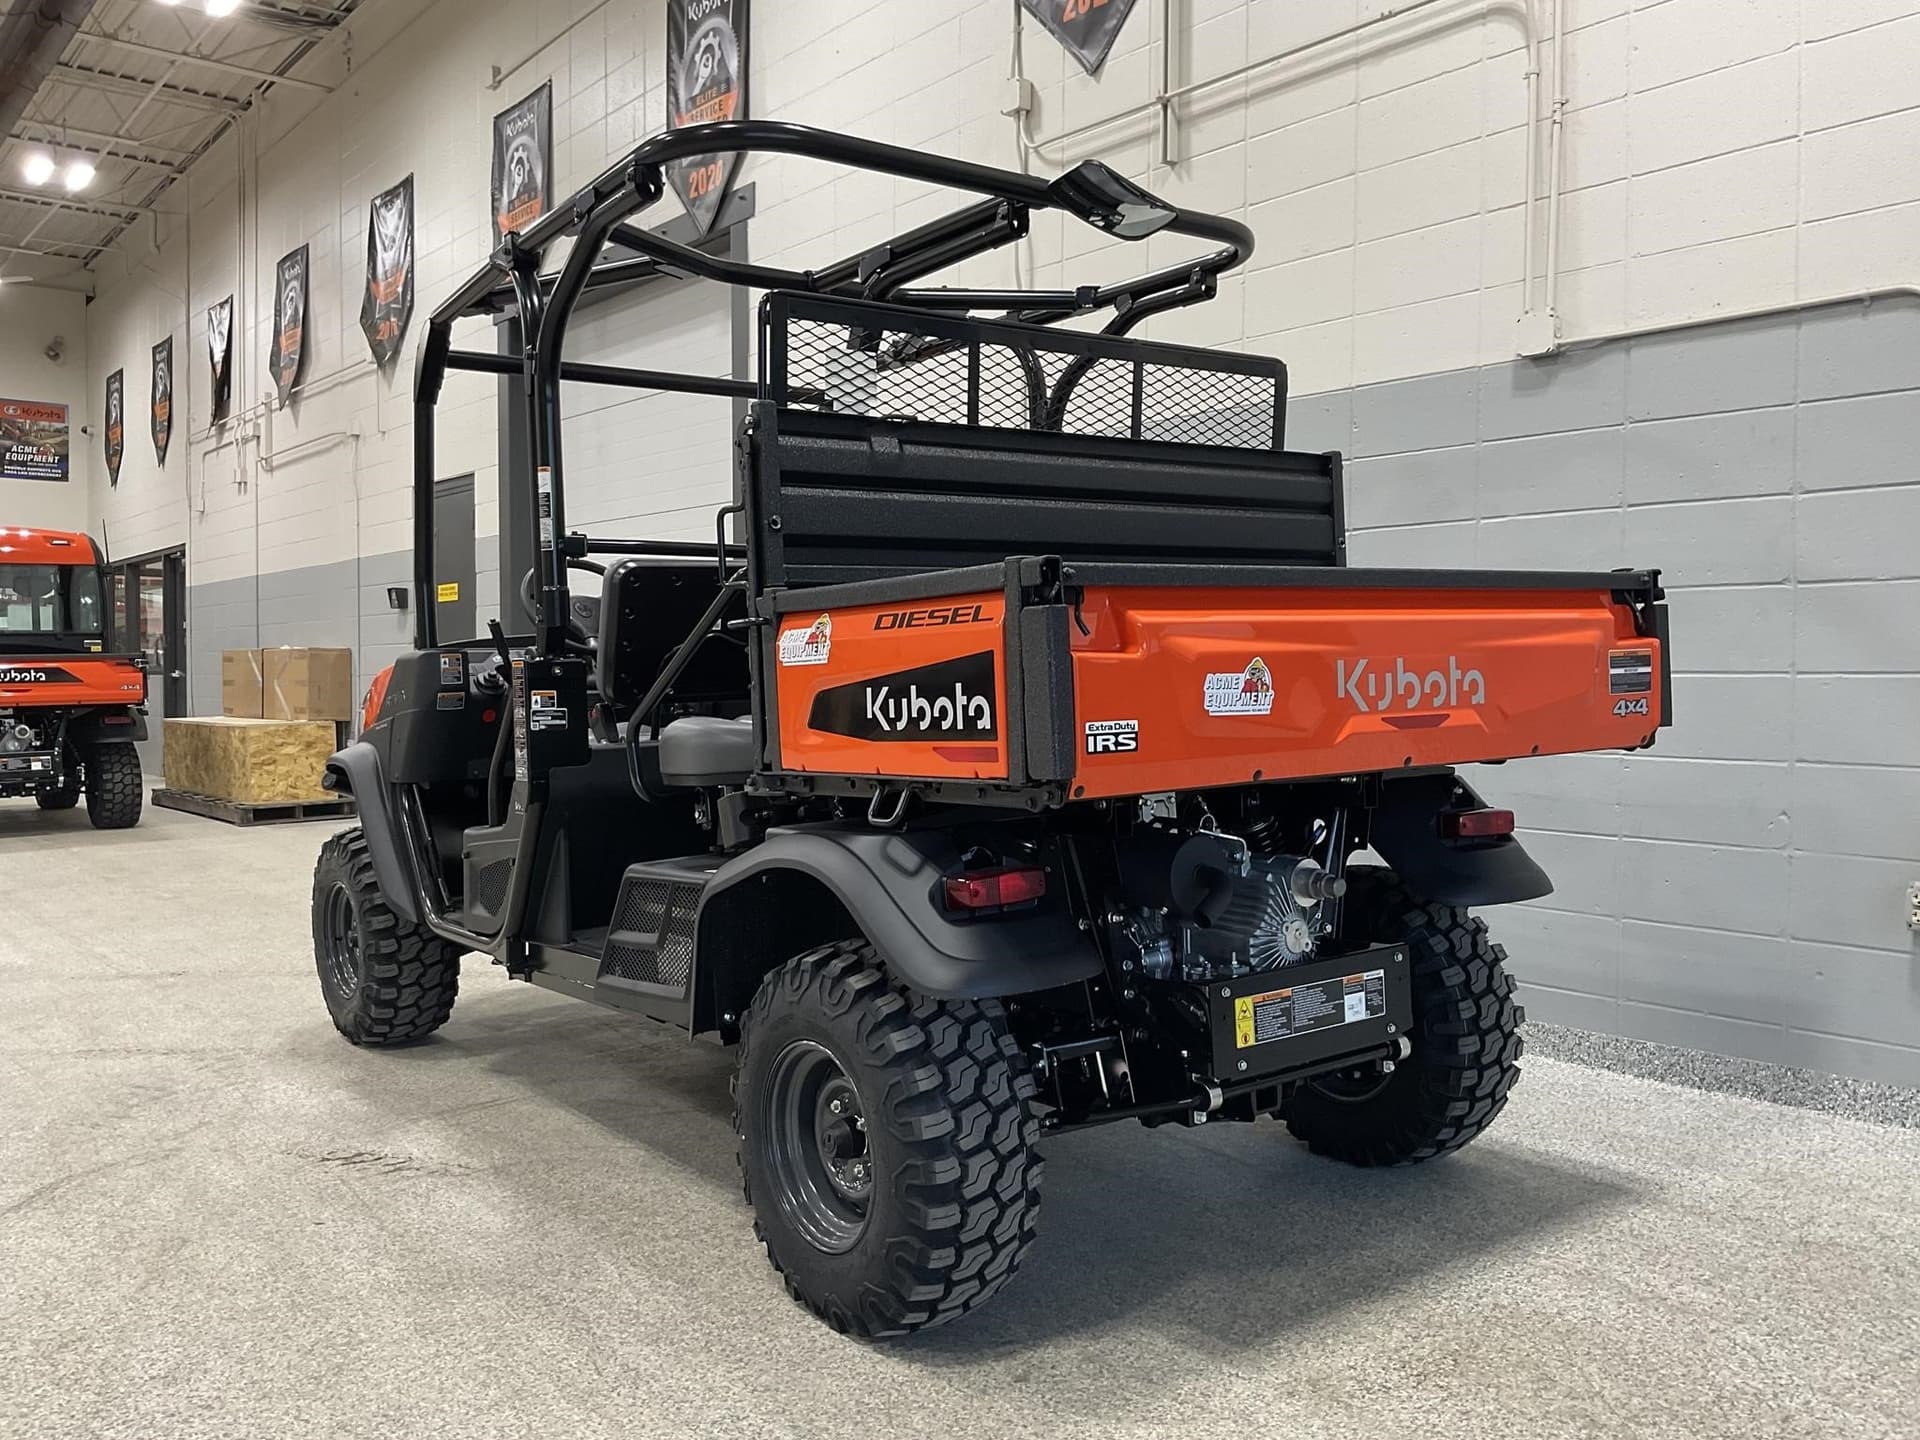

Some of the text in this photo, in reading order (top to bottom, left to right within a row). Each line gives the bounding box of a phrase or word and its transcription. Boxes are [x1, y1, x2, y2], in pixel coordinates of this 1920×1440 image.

[690, 99, 724, 121] SERVICE
[689, 160, 723, 199] 2020
[22, 407, 61, 419] Kubota
[5, 452, 60, 463] EQUIPMENT
[11, 445, 39, 454] ACME
[874, 605, 994, 631] DIESEL
[780, 643, 829, 659] EQUIPMENT
[1206, 674, 1240, 690] ACME
[1337, 656, 1485, 712] Kubota
[866, 682, 991, 731] Kubota
[1206, 691, 1273, 708] EQUIPMENT
[1613, 699, 1648, 716] 4x4
[1088, 721, 1136, 732] Extra Duty
[1087, 734, 1137, 752] IRS
